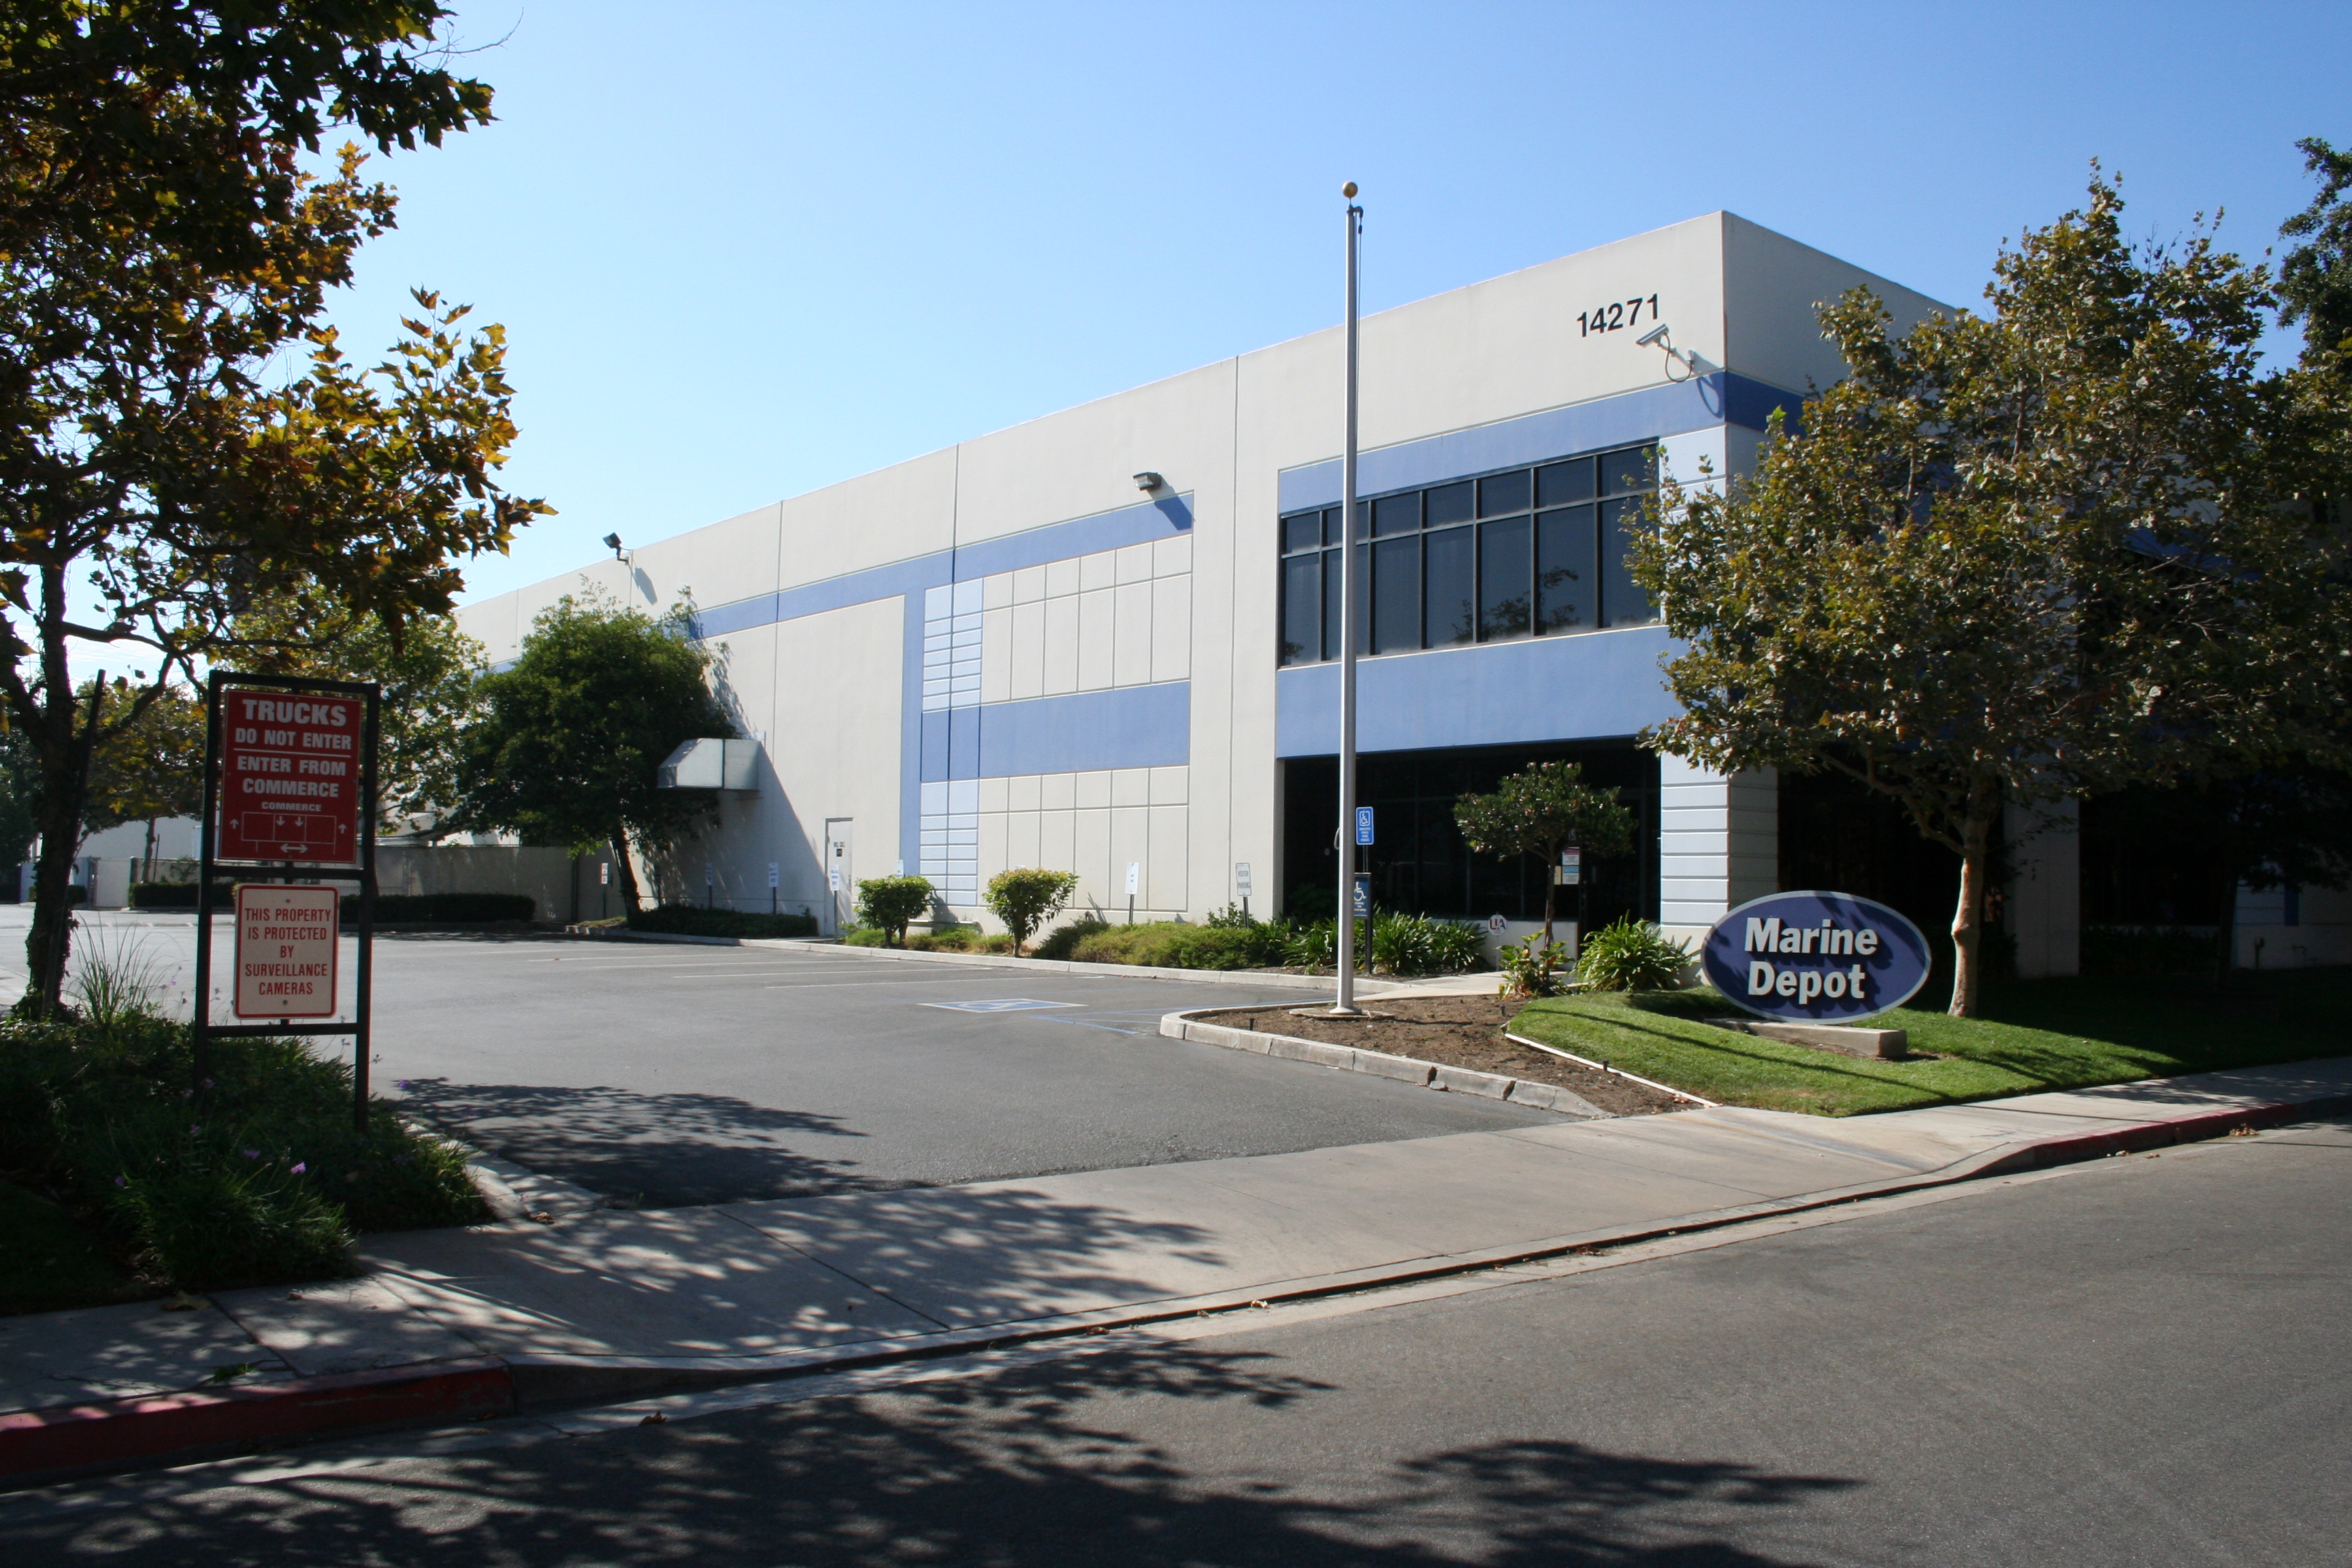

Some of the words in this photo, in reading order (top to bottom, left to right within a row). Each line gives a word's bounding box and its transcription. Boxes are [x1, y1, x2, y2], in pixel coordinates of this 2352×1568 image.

[1576, 293, 1658, 338] 14271
[242, 698, 346, 727] TRUCKS
[235, 728, 257, 744] DO
[264, 730, 296, 747] NOT
[303, 733, 352, 750] ENTER
[237, 755, 291, 773] ENTER
[299, 760, 346, 777] FROM
[242, 778, 340, 798] COMMERCE
[261, 801, 322, 813] COMMERCE
[244, 908, 270, 921] THIS
[275, 909, 331, 922] PROPERTY
[248, 927, 259, 940] IS
[264, 927, 327, 941] PROTECTED
[1744, 917, 1878, 956] Marine
[280, 945, 294, 958] BY
[245, 963, 328, 977] SURVEILLANCE
[259, 982, 313, 995] CAMERAS
[1747, 960, 1865, 1004] Depot
